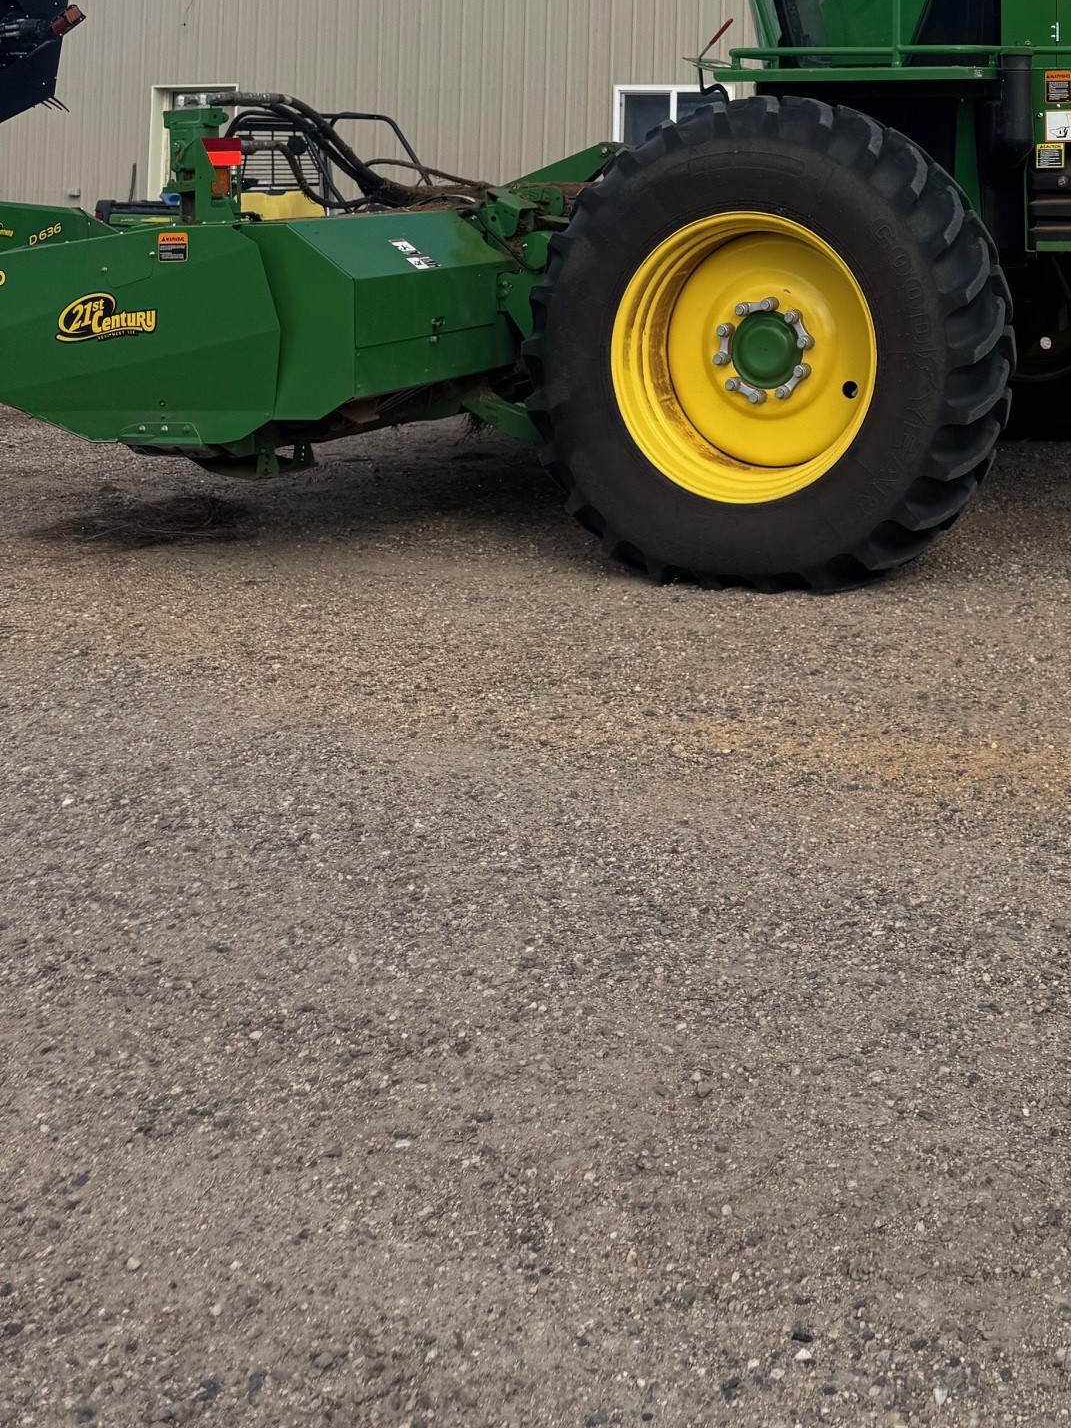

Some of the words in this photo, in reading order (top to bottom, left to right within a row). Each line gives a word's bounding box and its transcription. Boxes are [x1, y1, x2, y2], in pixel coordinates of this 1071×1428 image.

[29, 234, 38, 246] D
[39, 222, 62, 240] 636
[68, 298, 105, 333] 21st
[91, 309, 156, 334] Century
